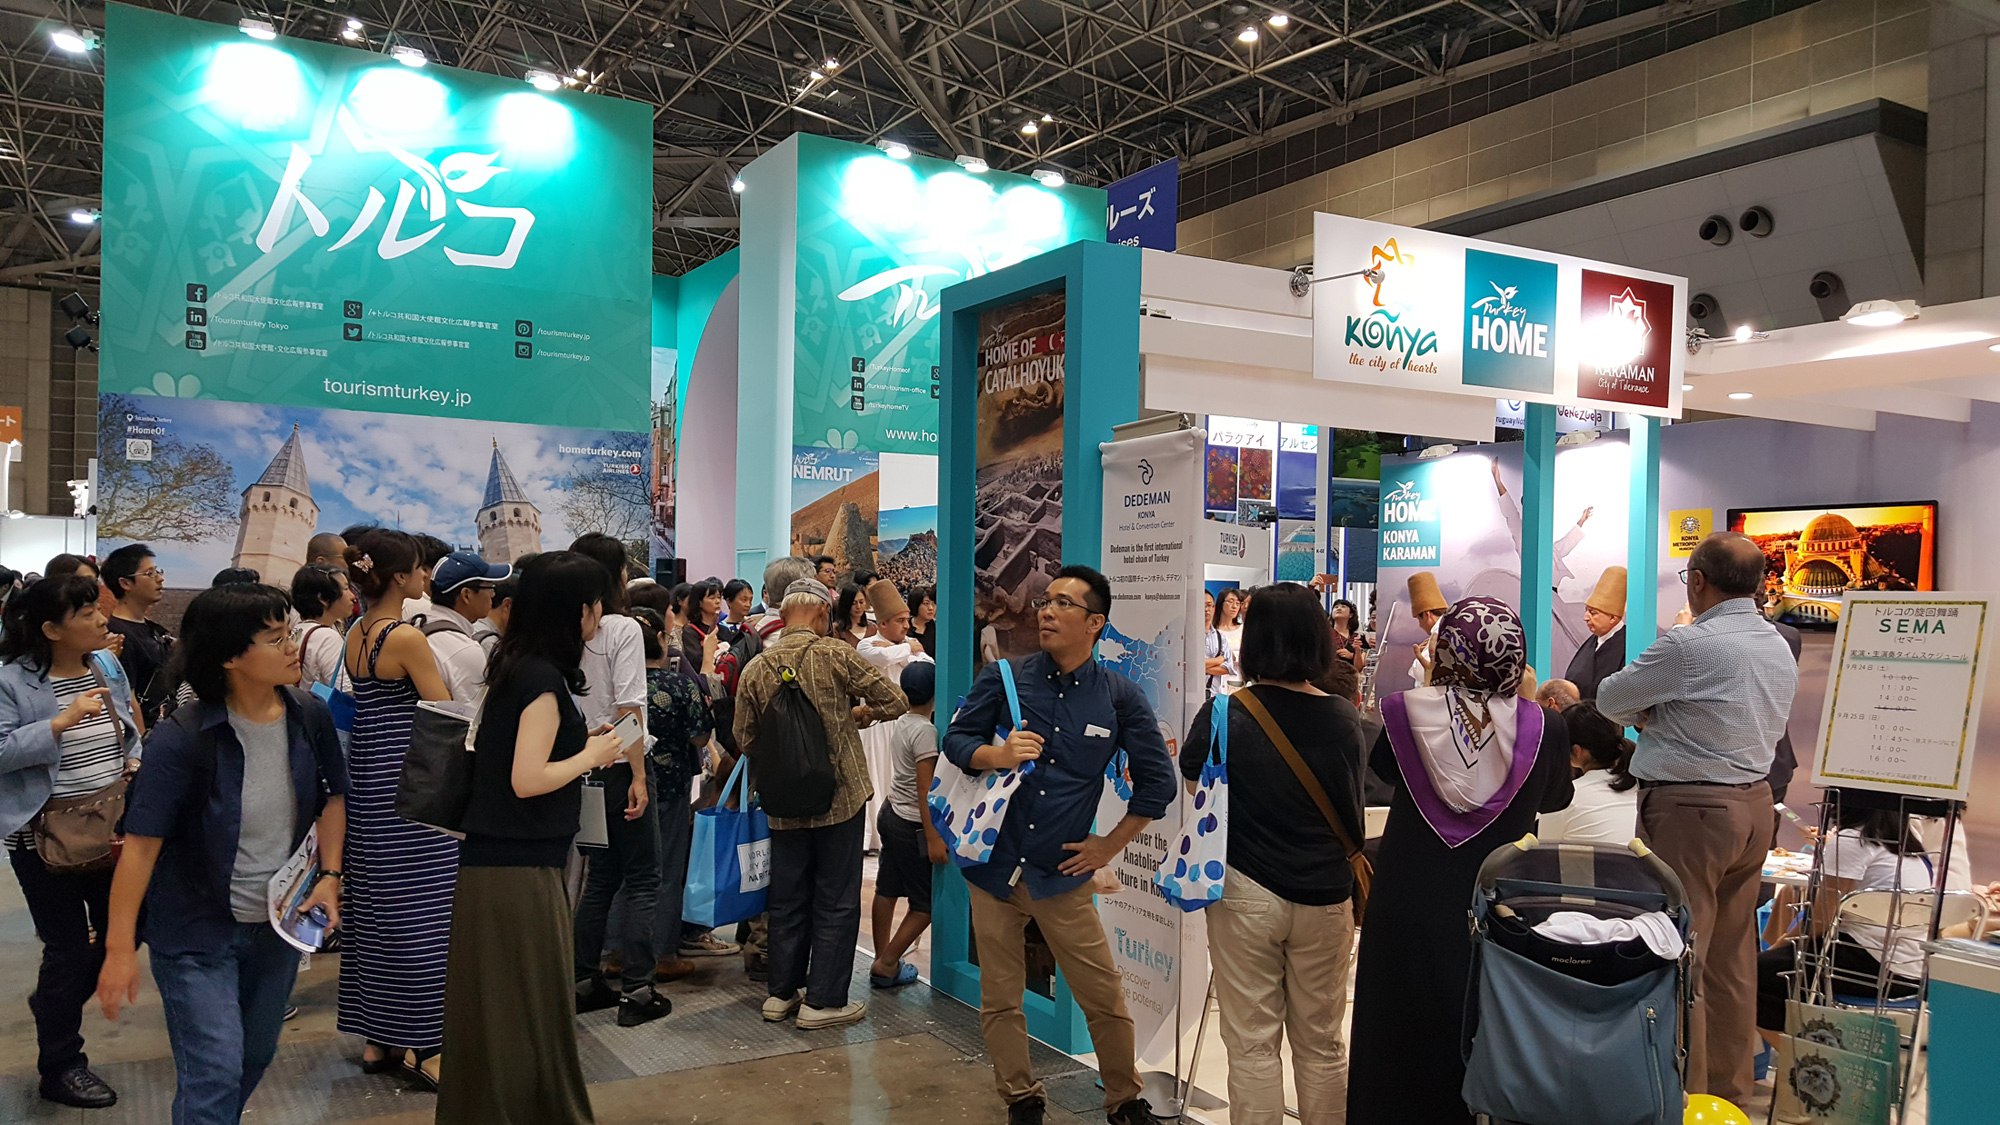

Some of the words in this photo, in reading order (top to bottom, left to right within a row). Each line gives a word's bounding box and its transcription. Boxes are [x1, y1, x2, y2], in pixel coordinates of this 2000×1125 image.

[256, 143, 536, 270] トルコ
[267, 321, 289, 331] Tokyo
[537, 327, 591, 341] /tourismturkey.jp
[1471, 314, 1549, 358] HOME
[537, 348, 591, 362] /tourismturkey.jp
[985, 341, 1019, 366] HOME
[1020, 336, 1037, 358] OF
[1349, 352, 1365, 366] the
[1368, 355, 1387, 372] city
[1390, 357, 1402, 369] of
[1407, 360, 1438, 374] hearts
[985, 353, 1066, 395] CATALHOYUK
[323, 378, 472, 407] tourismturkey.jp
[126, 426, 165, 435] #HomeOf
[558, 444, 641, 459] hometurkey.com
[793, 465, 853, 482] NEMRUT
[1124, 491, 1171, 507] DEDEMAN
[1137, 511, 1156, 519] KONYA
[1384, 500, 1437, 523] HOME
[1136, 522, 1160, 530] Convention
[1160, 520, 1175, 528] Center
[1220, 533, 1238, 544] TURKISH
[1383, 529, 1419, 544] KONYA
[1110, 544, 1130, 553] Dedeman
[1144, 542, 1154, 551] first
[1154, 540, 1183, 551] international
[1220, 544, 1238, 556] AIRLINES
[1383, 545, 1437, 561] KARAMAN
[1123, 555, 1135, 563] hotel
[1136, 554, 1148, 563] chain
[1154, 553, 1169, 563] Turkey
[1879, 618, 1946, 634] SEMA
[1132, 832, 1152, 847] over
[1155, 833, 1167, 852] the
[1115, 867, 1138, 889] lture
[1140, 874, 1148, 893] in
[1114, 926, 1173, 983] Turkey
[1117, 965, 1151, 990] Discover
[1132, 990, 1163, 1015] potential
